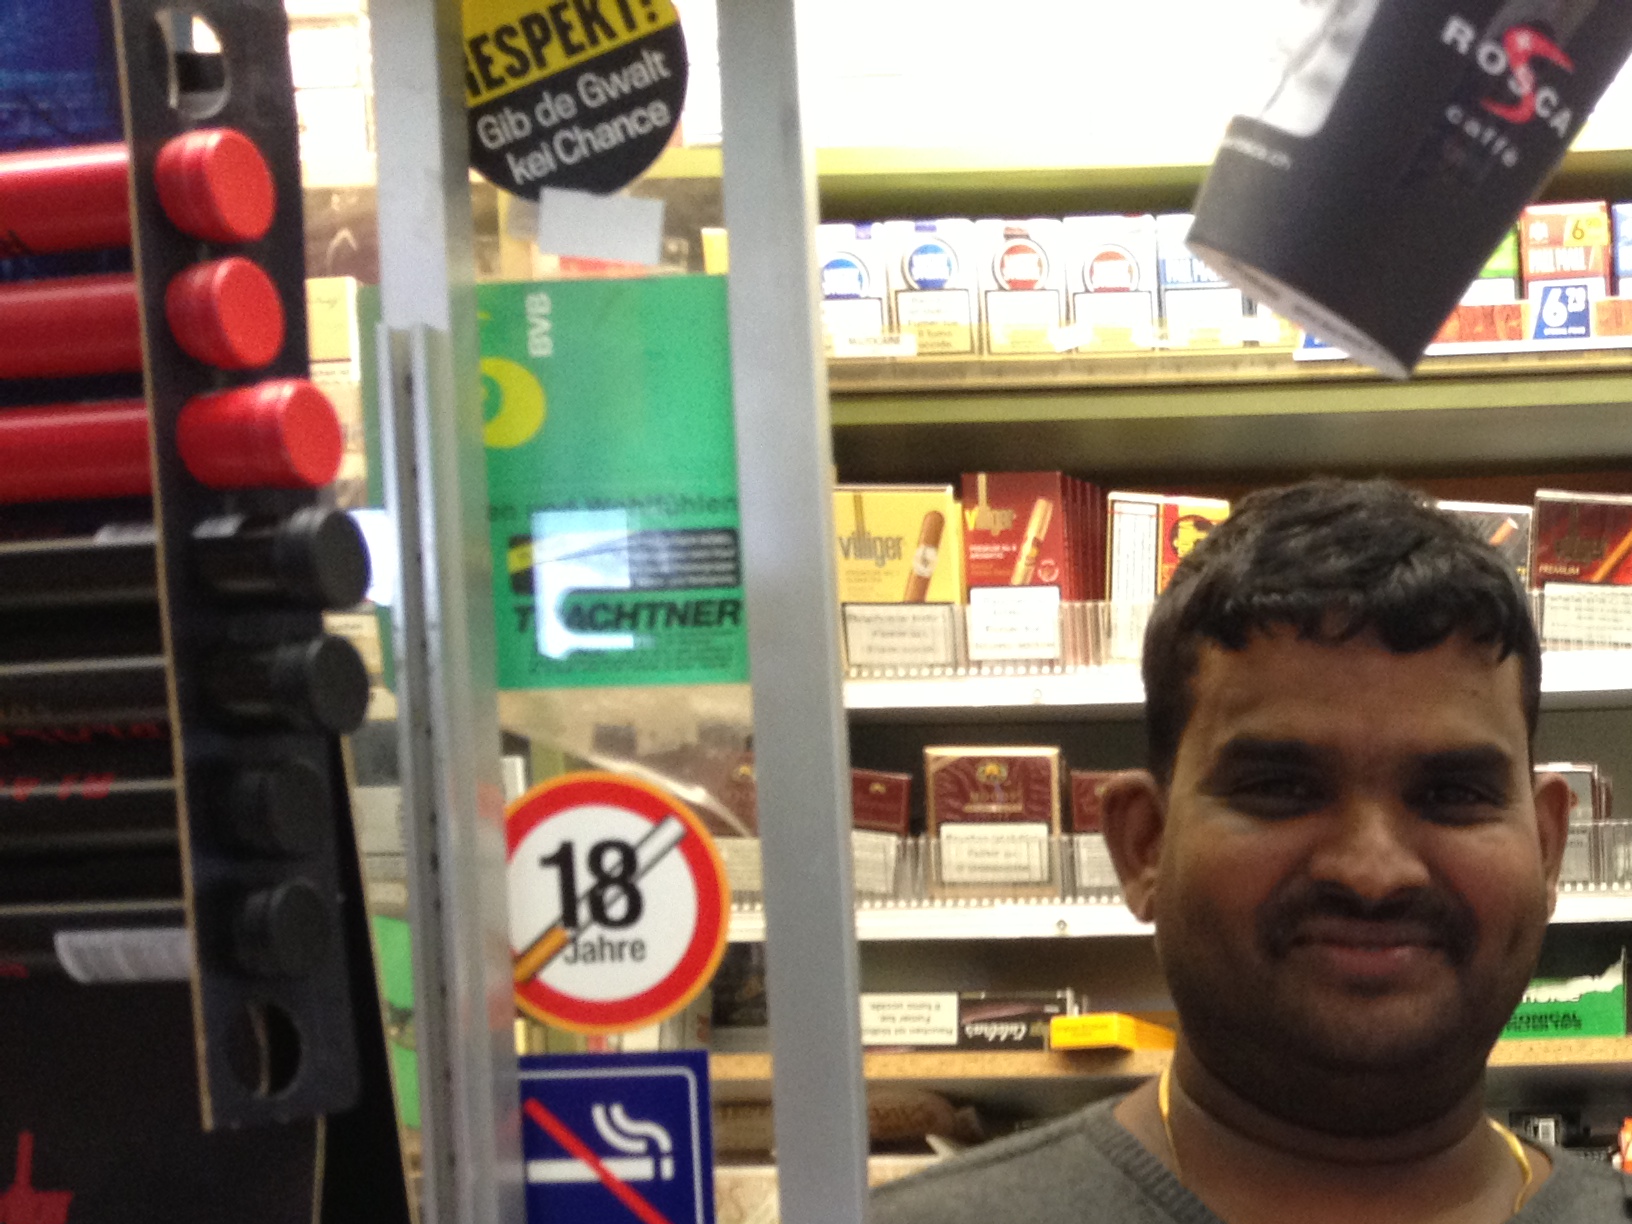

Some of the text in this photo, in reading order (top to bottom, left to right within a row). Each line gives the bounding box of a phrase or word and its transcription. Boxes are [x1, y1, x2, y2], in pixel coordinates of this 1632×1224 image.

[476, 48, 671, 150] Gib de Gwalt
[553, 99, 671, 165] Chance
[512, 598, 743, 634] TACHTNER
[537, 839, 645, 930] 18
[563, 936, 647, 965] Jahre
